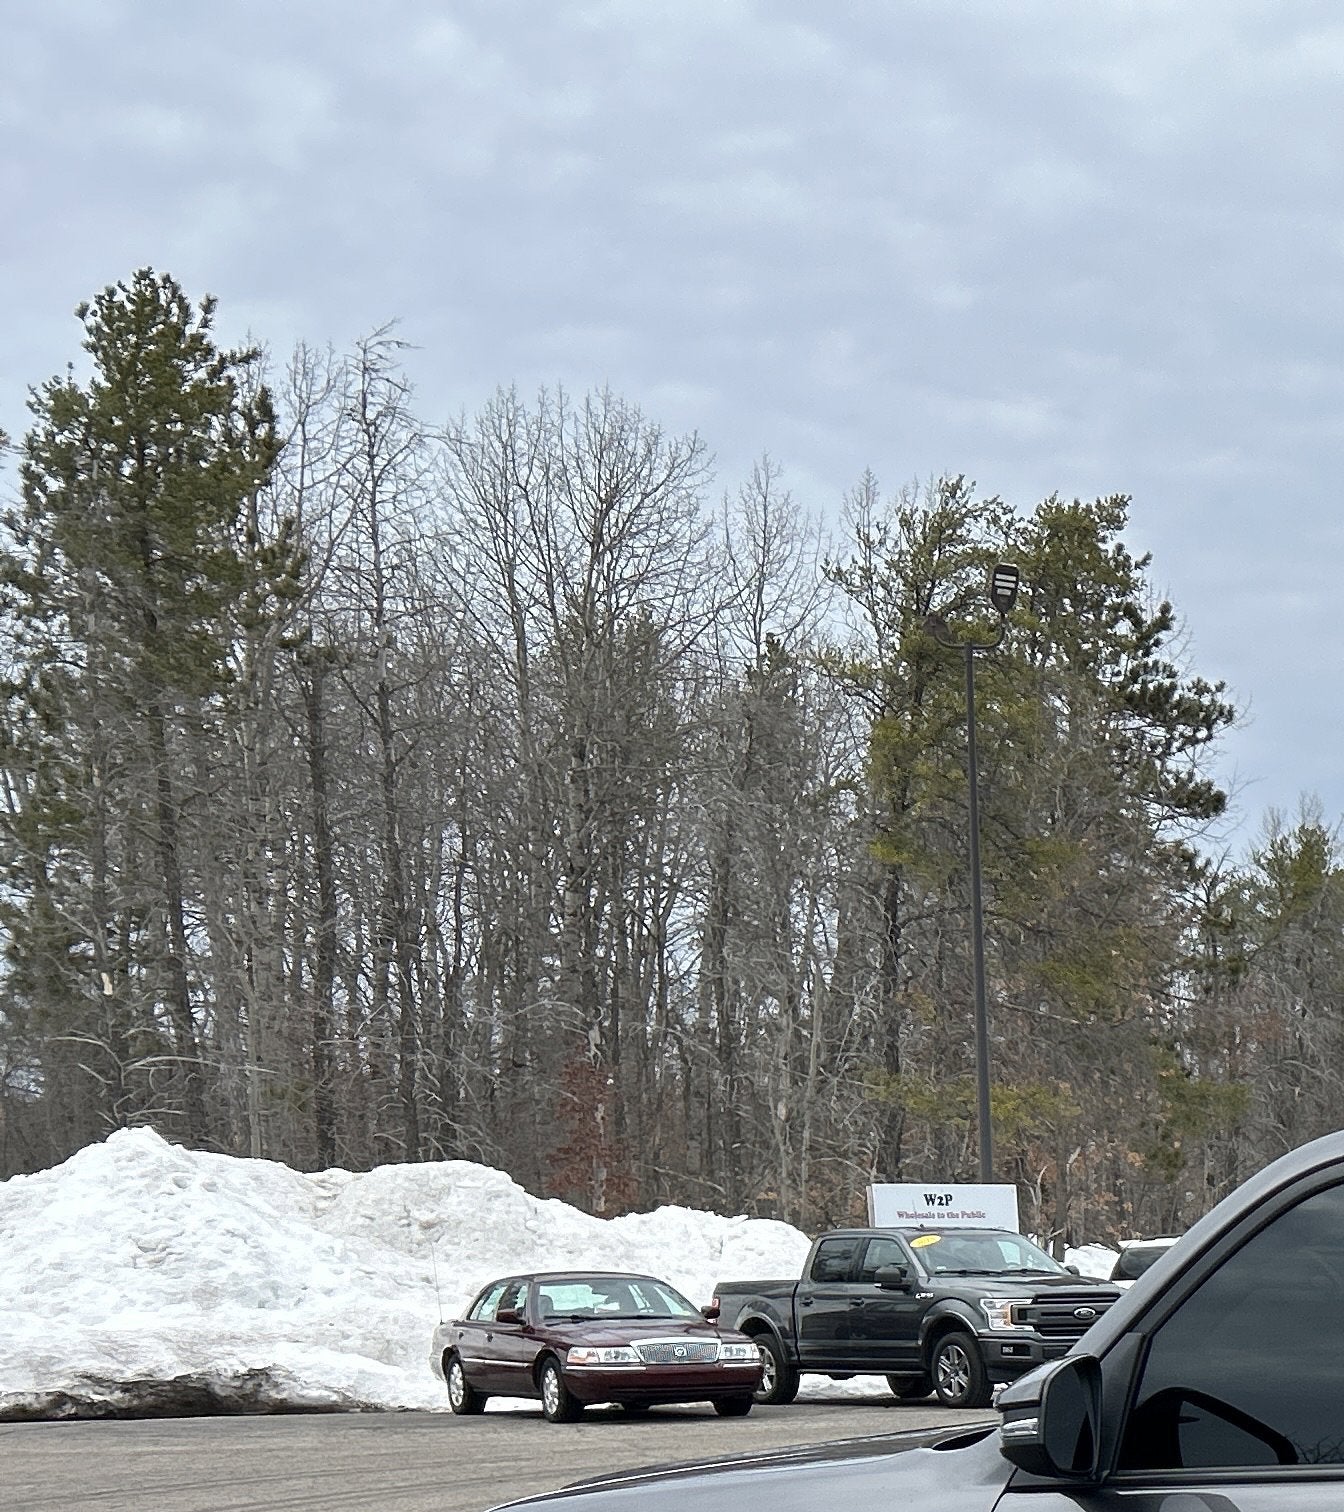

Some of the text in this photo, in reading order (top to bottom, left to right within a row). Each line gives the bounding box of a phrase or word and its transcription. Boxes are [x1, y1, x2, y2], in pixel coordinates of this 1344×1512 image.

[923, 1193, 953, 1206] W2P
[896, 1210, 986, 1219] Wholesale to the Public
